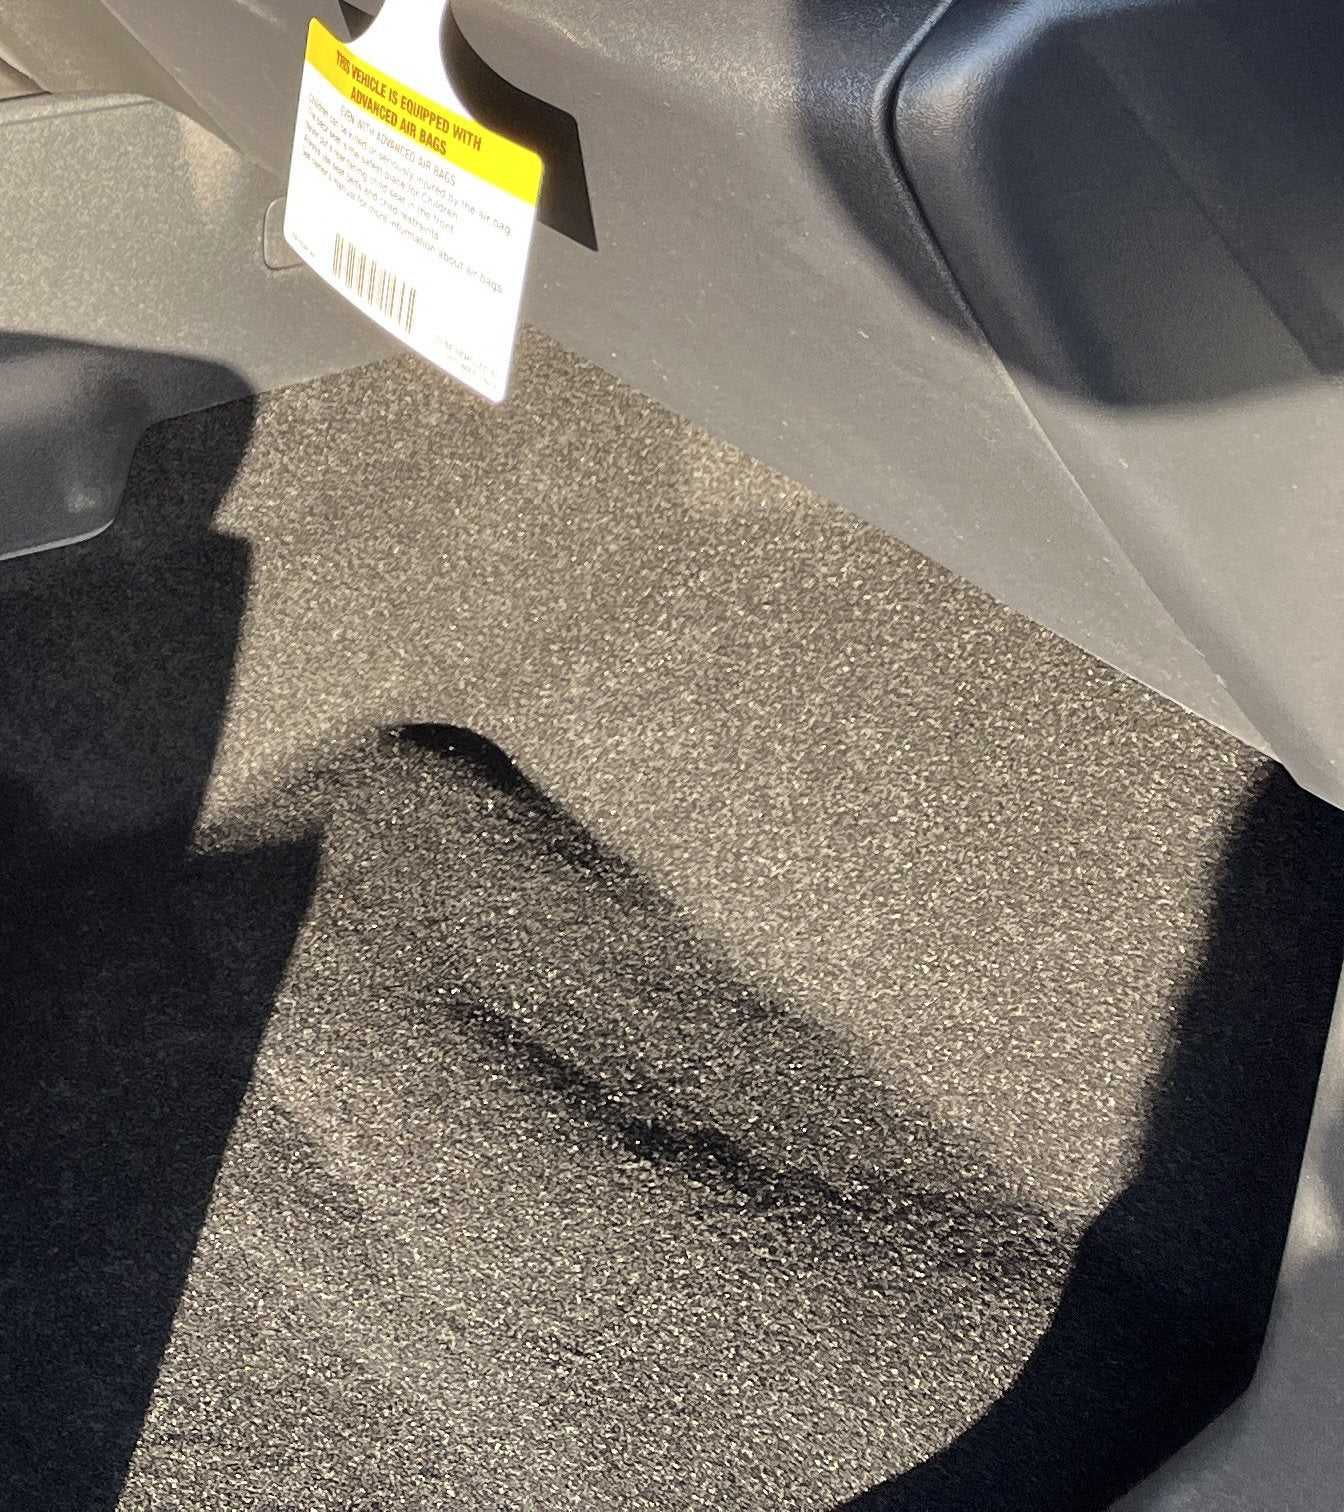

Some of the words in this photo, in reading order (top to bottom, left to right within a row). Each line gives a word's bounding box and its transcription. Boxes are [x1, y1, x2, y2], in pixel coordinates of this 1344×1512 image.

[336, 50, 351, 75] THIS
[351, 63, 388, 97] VEHICLE
[388, 89, 399, 105] IS
[399, 94, 450, 135] EQUIPPED
[452, 124, 483, 152] WITH
[350, 86, 399, 127] ADVANCED
[399, 118, 418, 140] AIR
[418, 129, 448, 156] BAGS
[341, 105, 355, 124] EVEN
[357, 118, 374, 137] WITH
[376, 132, 416, 163] ADVANCED
[417, 156, 432, 172] AIR
[433, 164, 456, 187] BAGS
[378, 153, 414, 182] seriously
[416, 175, 447, 199] injured
[447, 193, 459, 208] by
[461, 199, 476, 216] the
[478, 210, 491, 223] air
[492, 218, 512, 238] bag
[400, 209, 439, 241] restraints
[407, 183, 420, 198] for
[421, 192, 458, 221] Children
[417, 207, 431, 220] the
[433, 214, 454, 235] front
[389, 219, 436, 254] information
[437, 249, 464, 272] about
[465, 266, 478, 279] air
